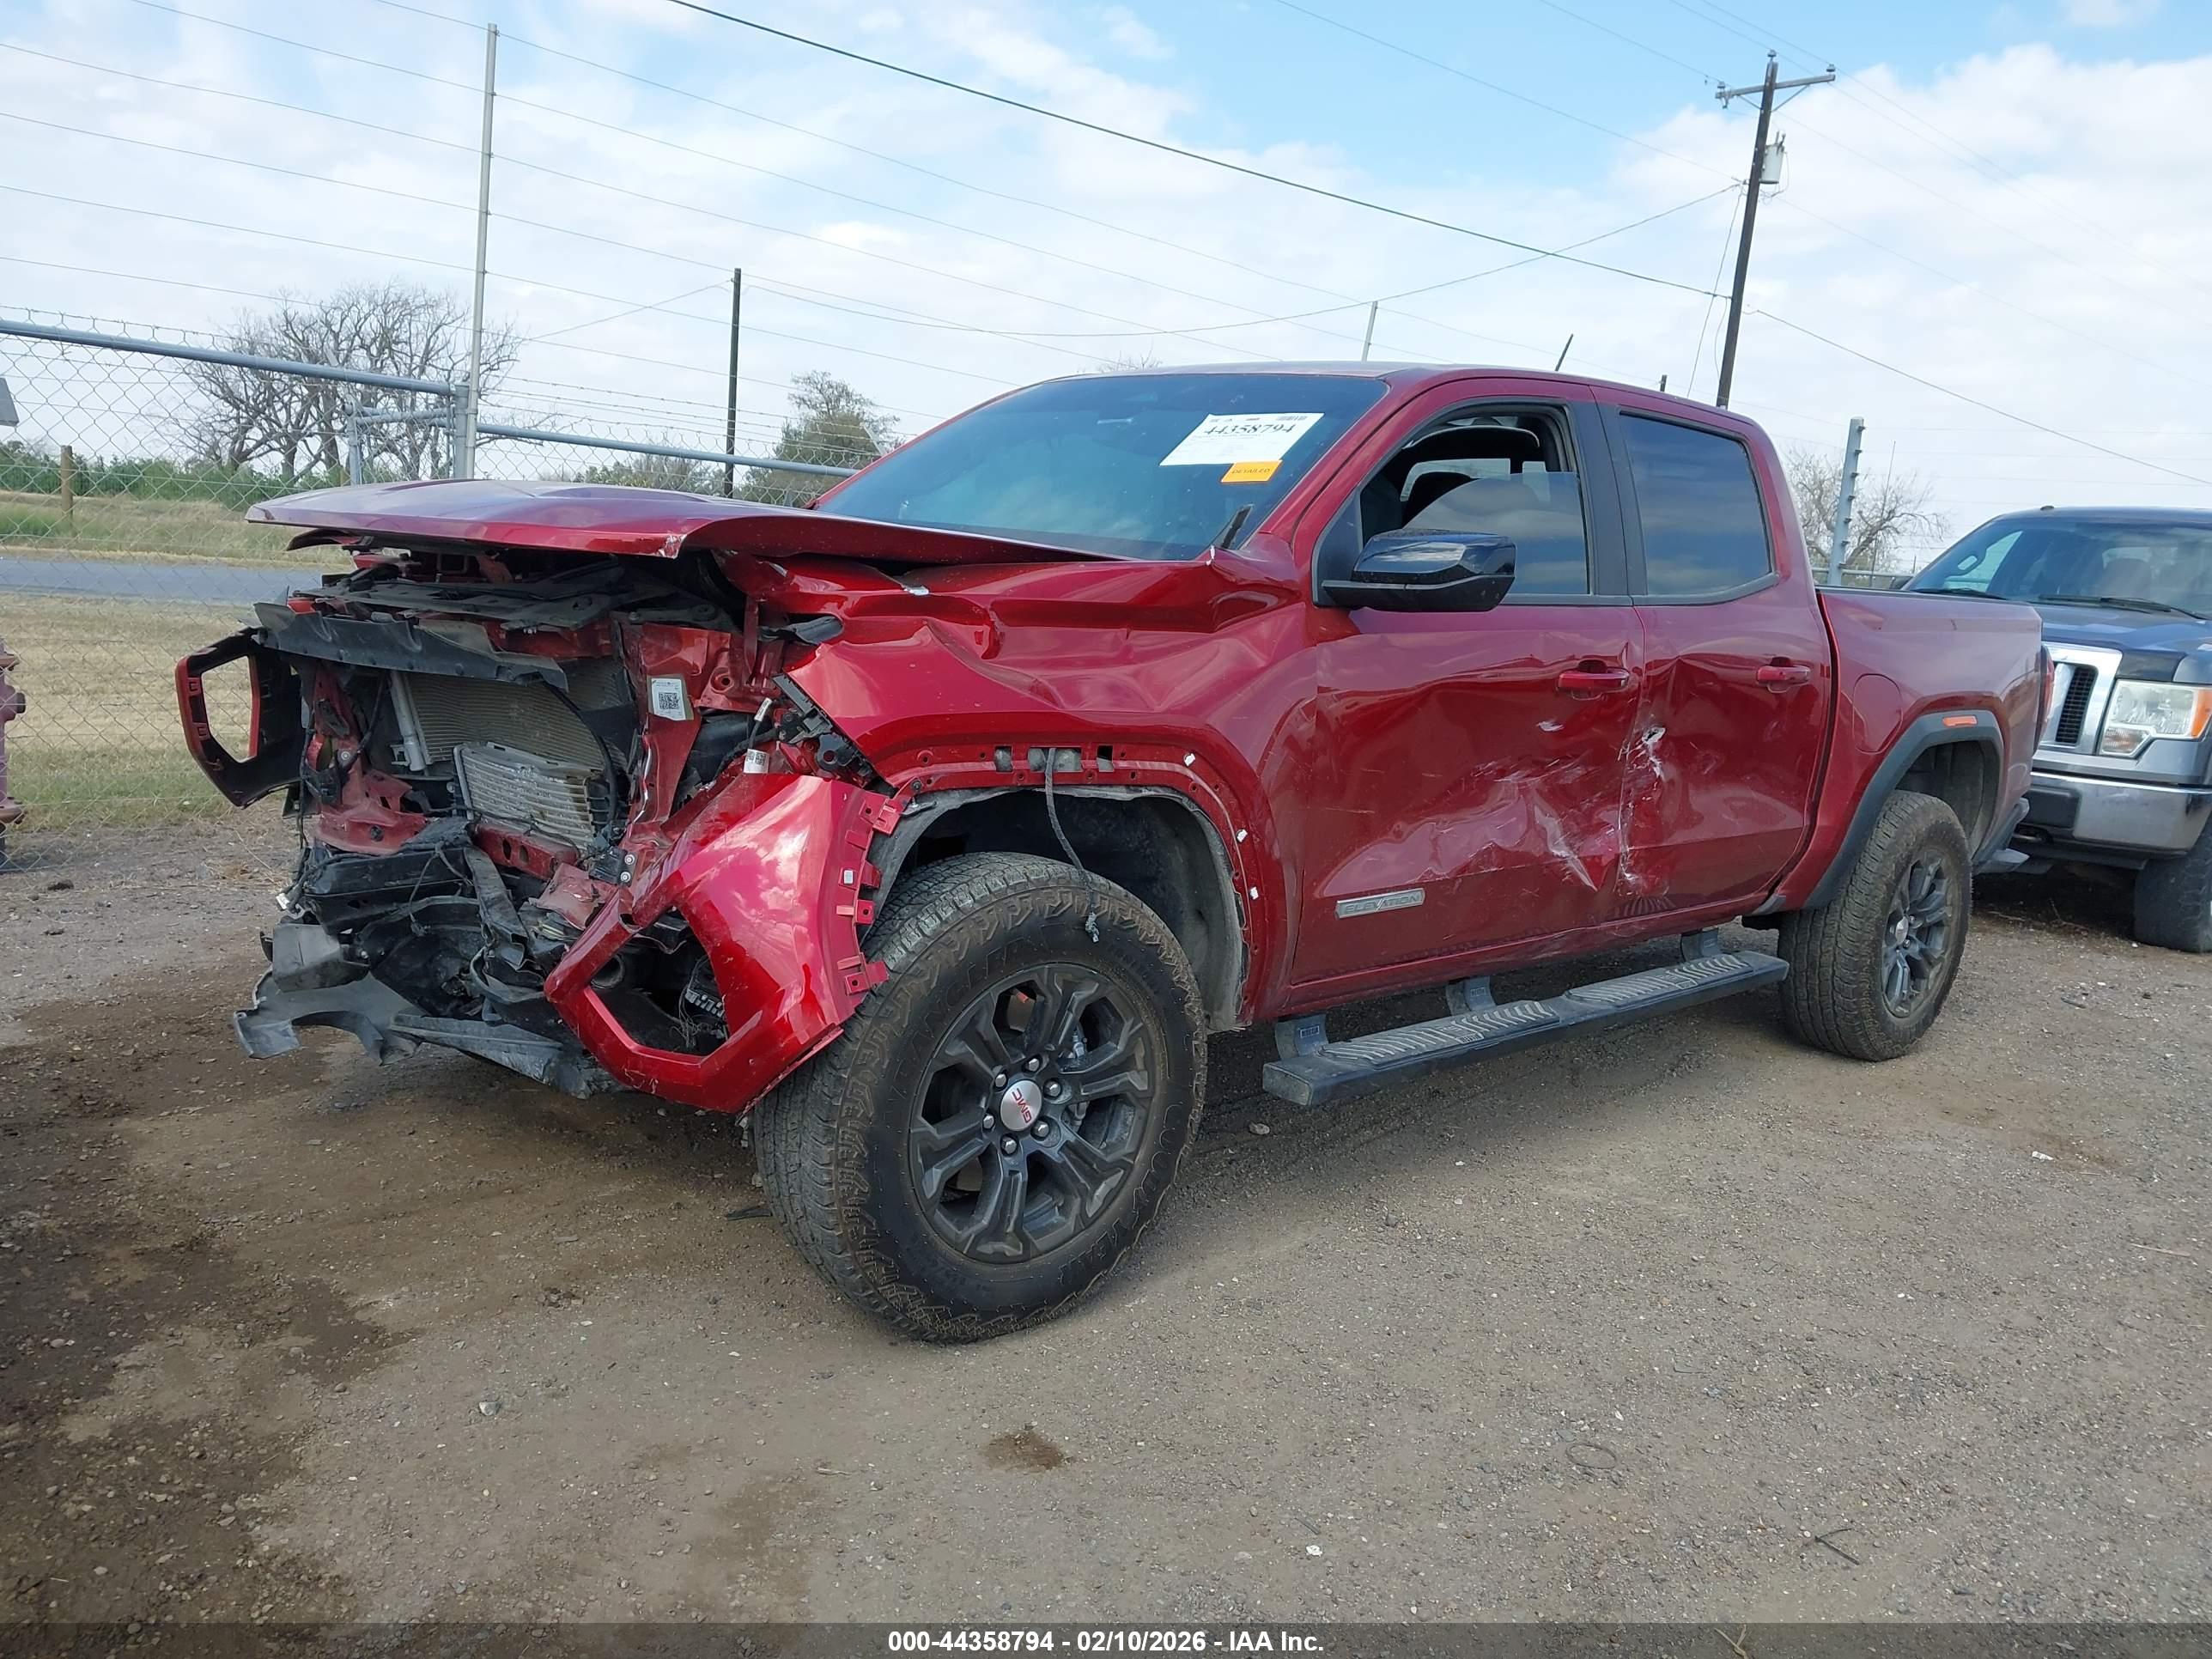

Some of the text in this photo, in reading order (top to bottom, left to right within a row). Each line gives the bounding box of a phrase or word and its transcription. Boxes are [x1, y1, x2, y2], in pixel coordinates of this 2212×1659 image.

[1204, 423, 1295, 434] 44358794
[1344, 893, 1420, 915] ELEVATION
[1011, 1087, 1032, 1124] GMC
